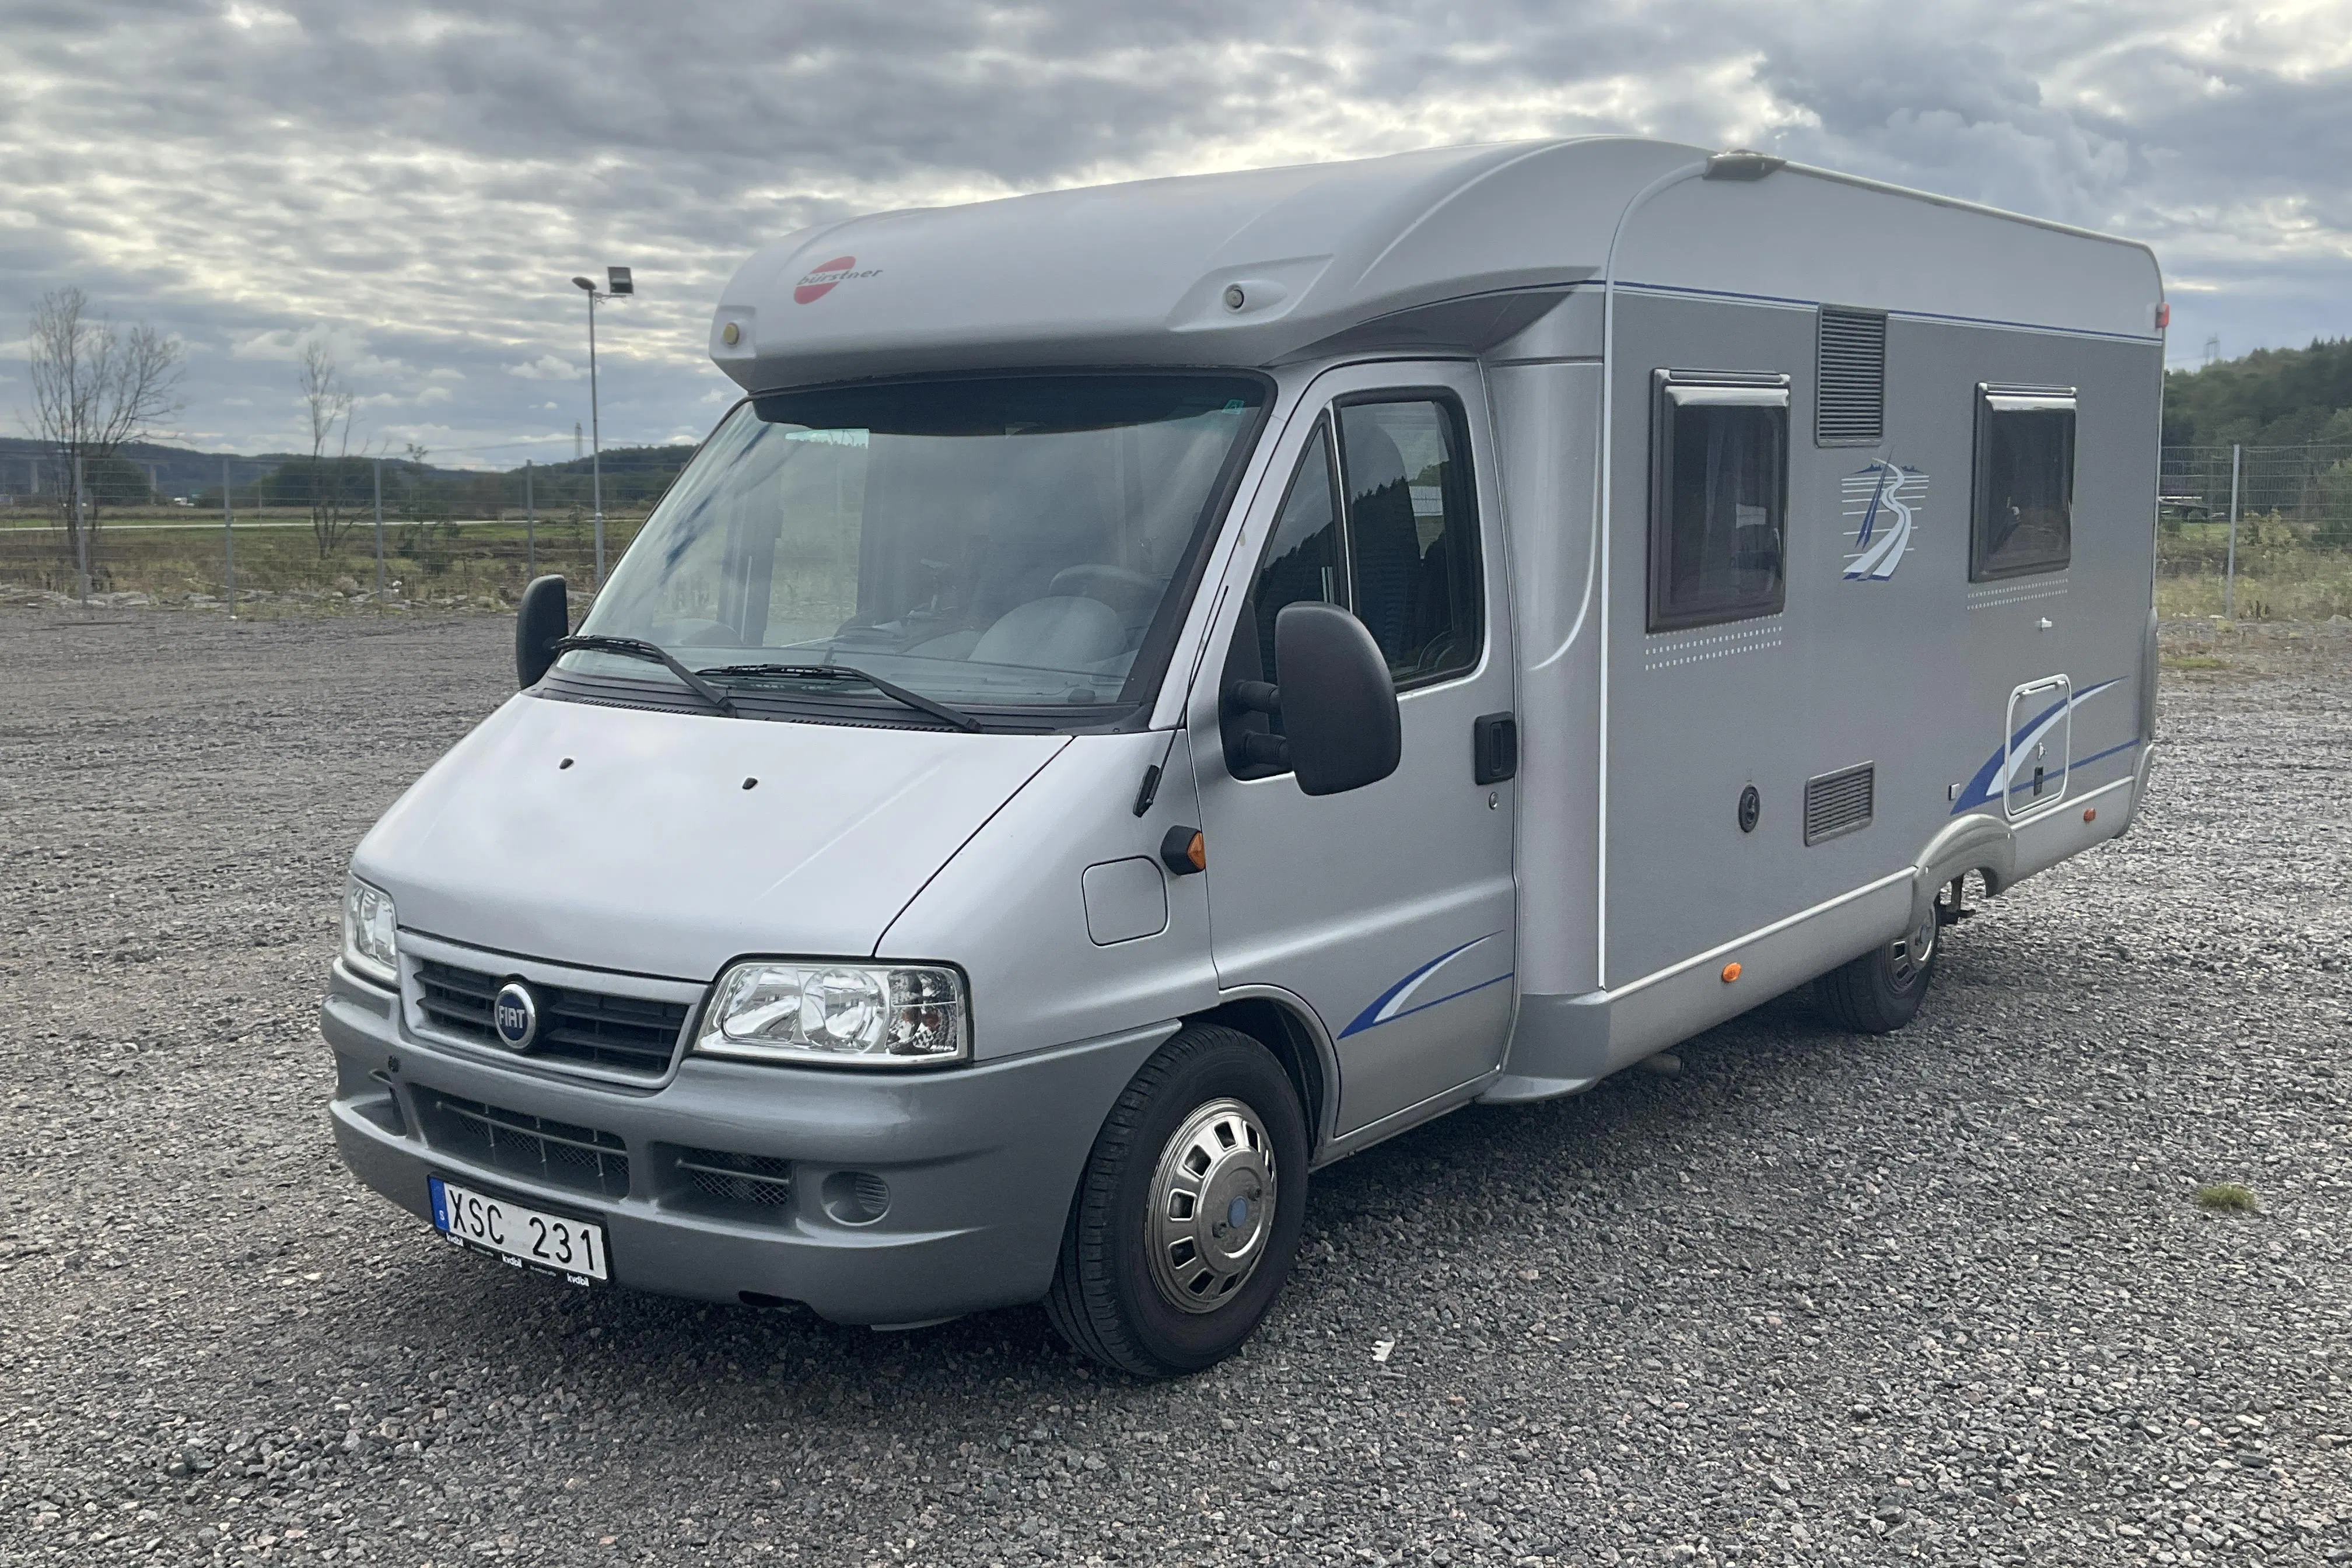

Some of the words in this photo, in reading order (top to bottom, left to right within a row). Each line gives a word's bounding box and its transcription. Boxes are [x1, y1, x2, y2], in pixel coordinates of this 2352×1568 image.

[499, 1006, 525, 1028] FIAT
[439, 1210, 444, 1221] S
[449, 1189, 505, 1245] XSC
[529, 1216, 594, 1270] 231
